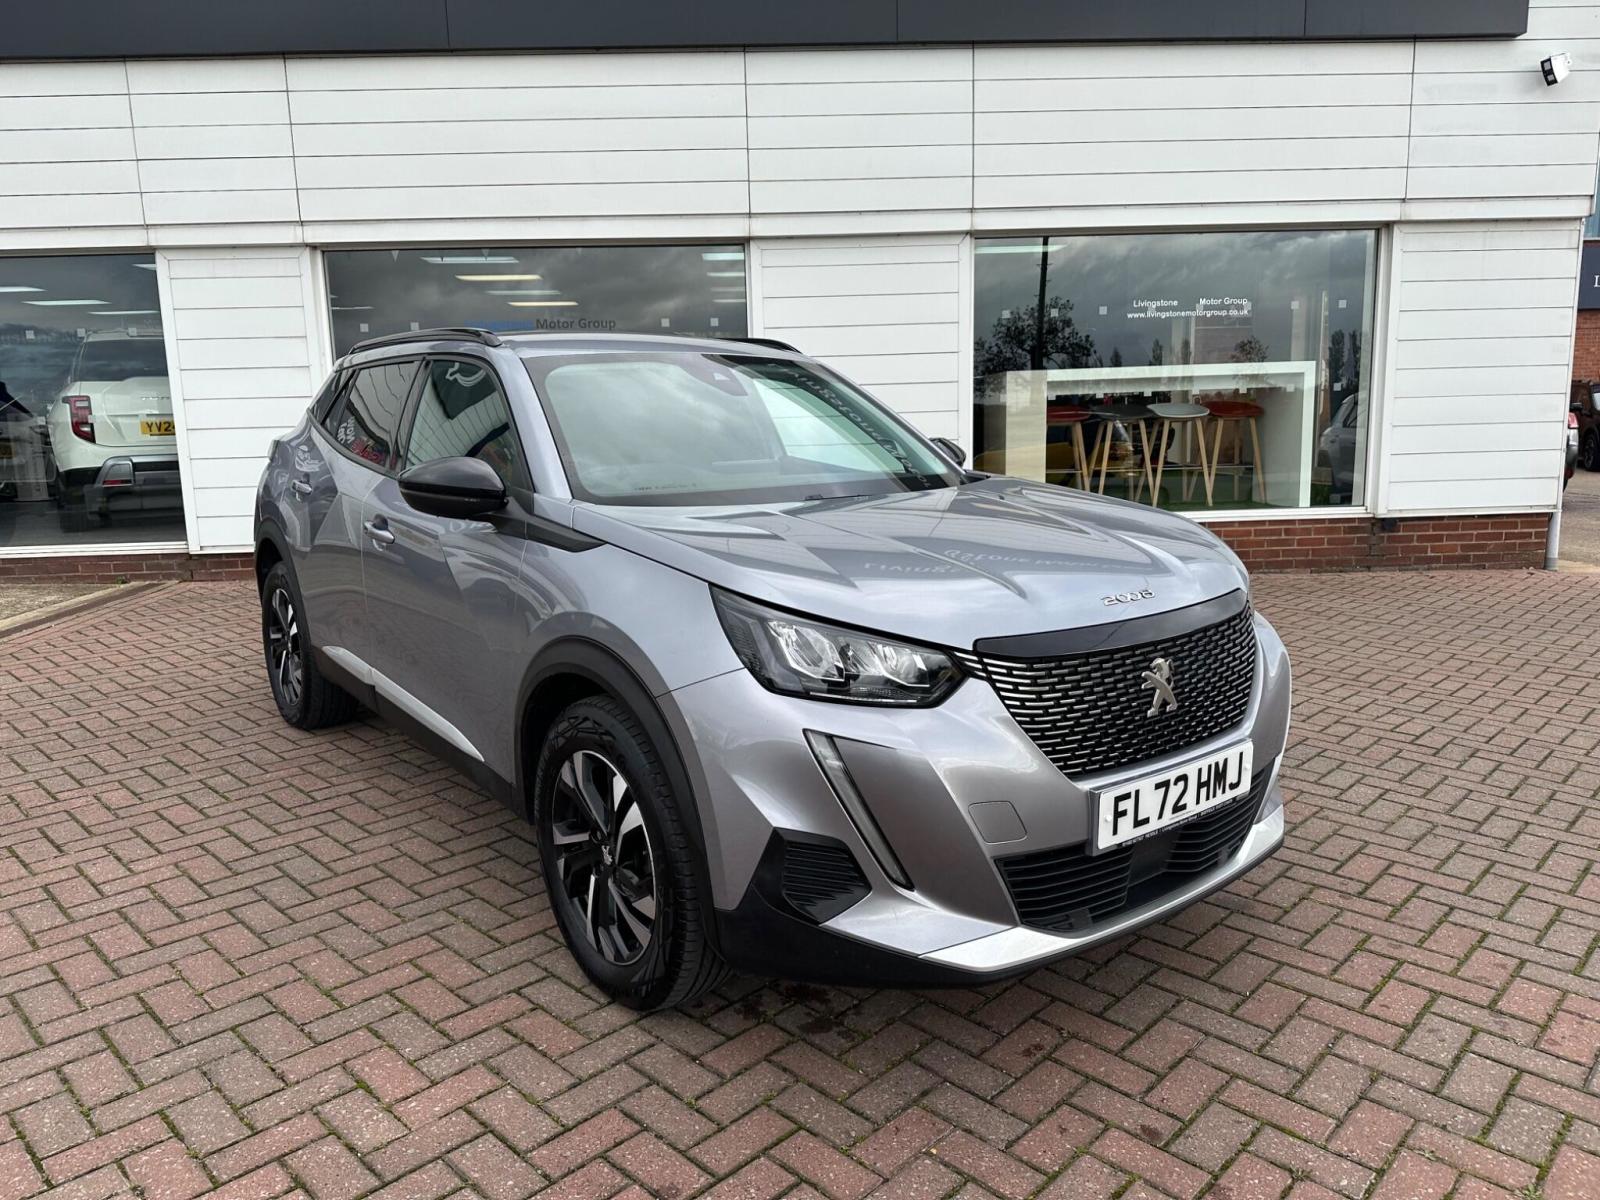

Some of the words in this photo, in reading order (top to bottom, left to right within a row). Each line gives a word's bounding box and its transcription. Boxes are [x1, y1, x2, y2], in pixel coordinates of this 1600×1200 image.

[1133, 300, 1179, 308] Livingstone
[1199, 297, 1223, 306] Motor
[1223, 296, 1249, 307] Group
[1126, 308, 1249, 319] www.livingstonemotorgroup.co.uk
[535, 317, 575, 330] Motor
[578, 317, 616, 331] Group
[145, 421, 175, 433] YV2
[1112, 773, 1189, 837] FL72
[1195, 751, 1244, 806] HMJ
